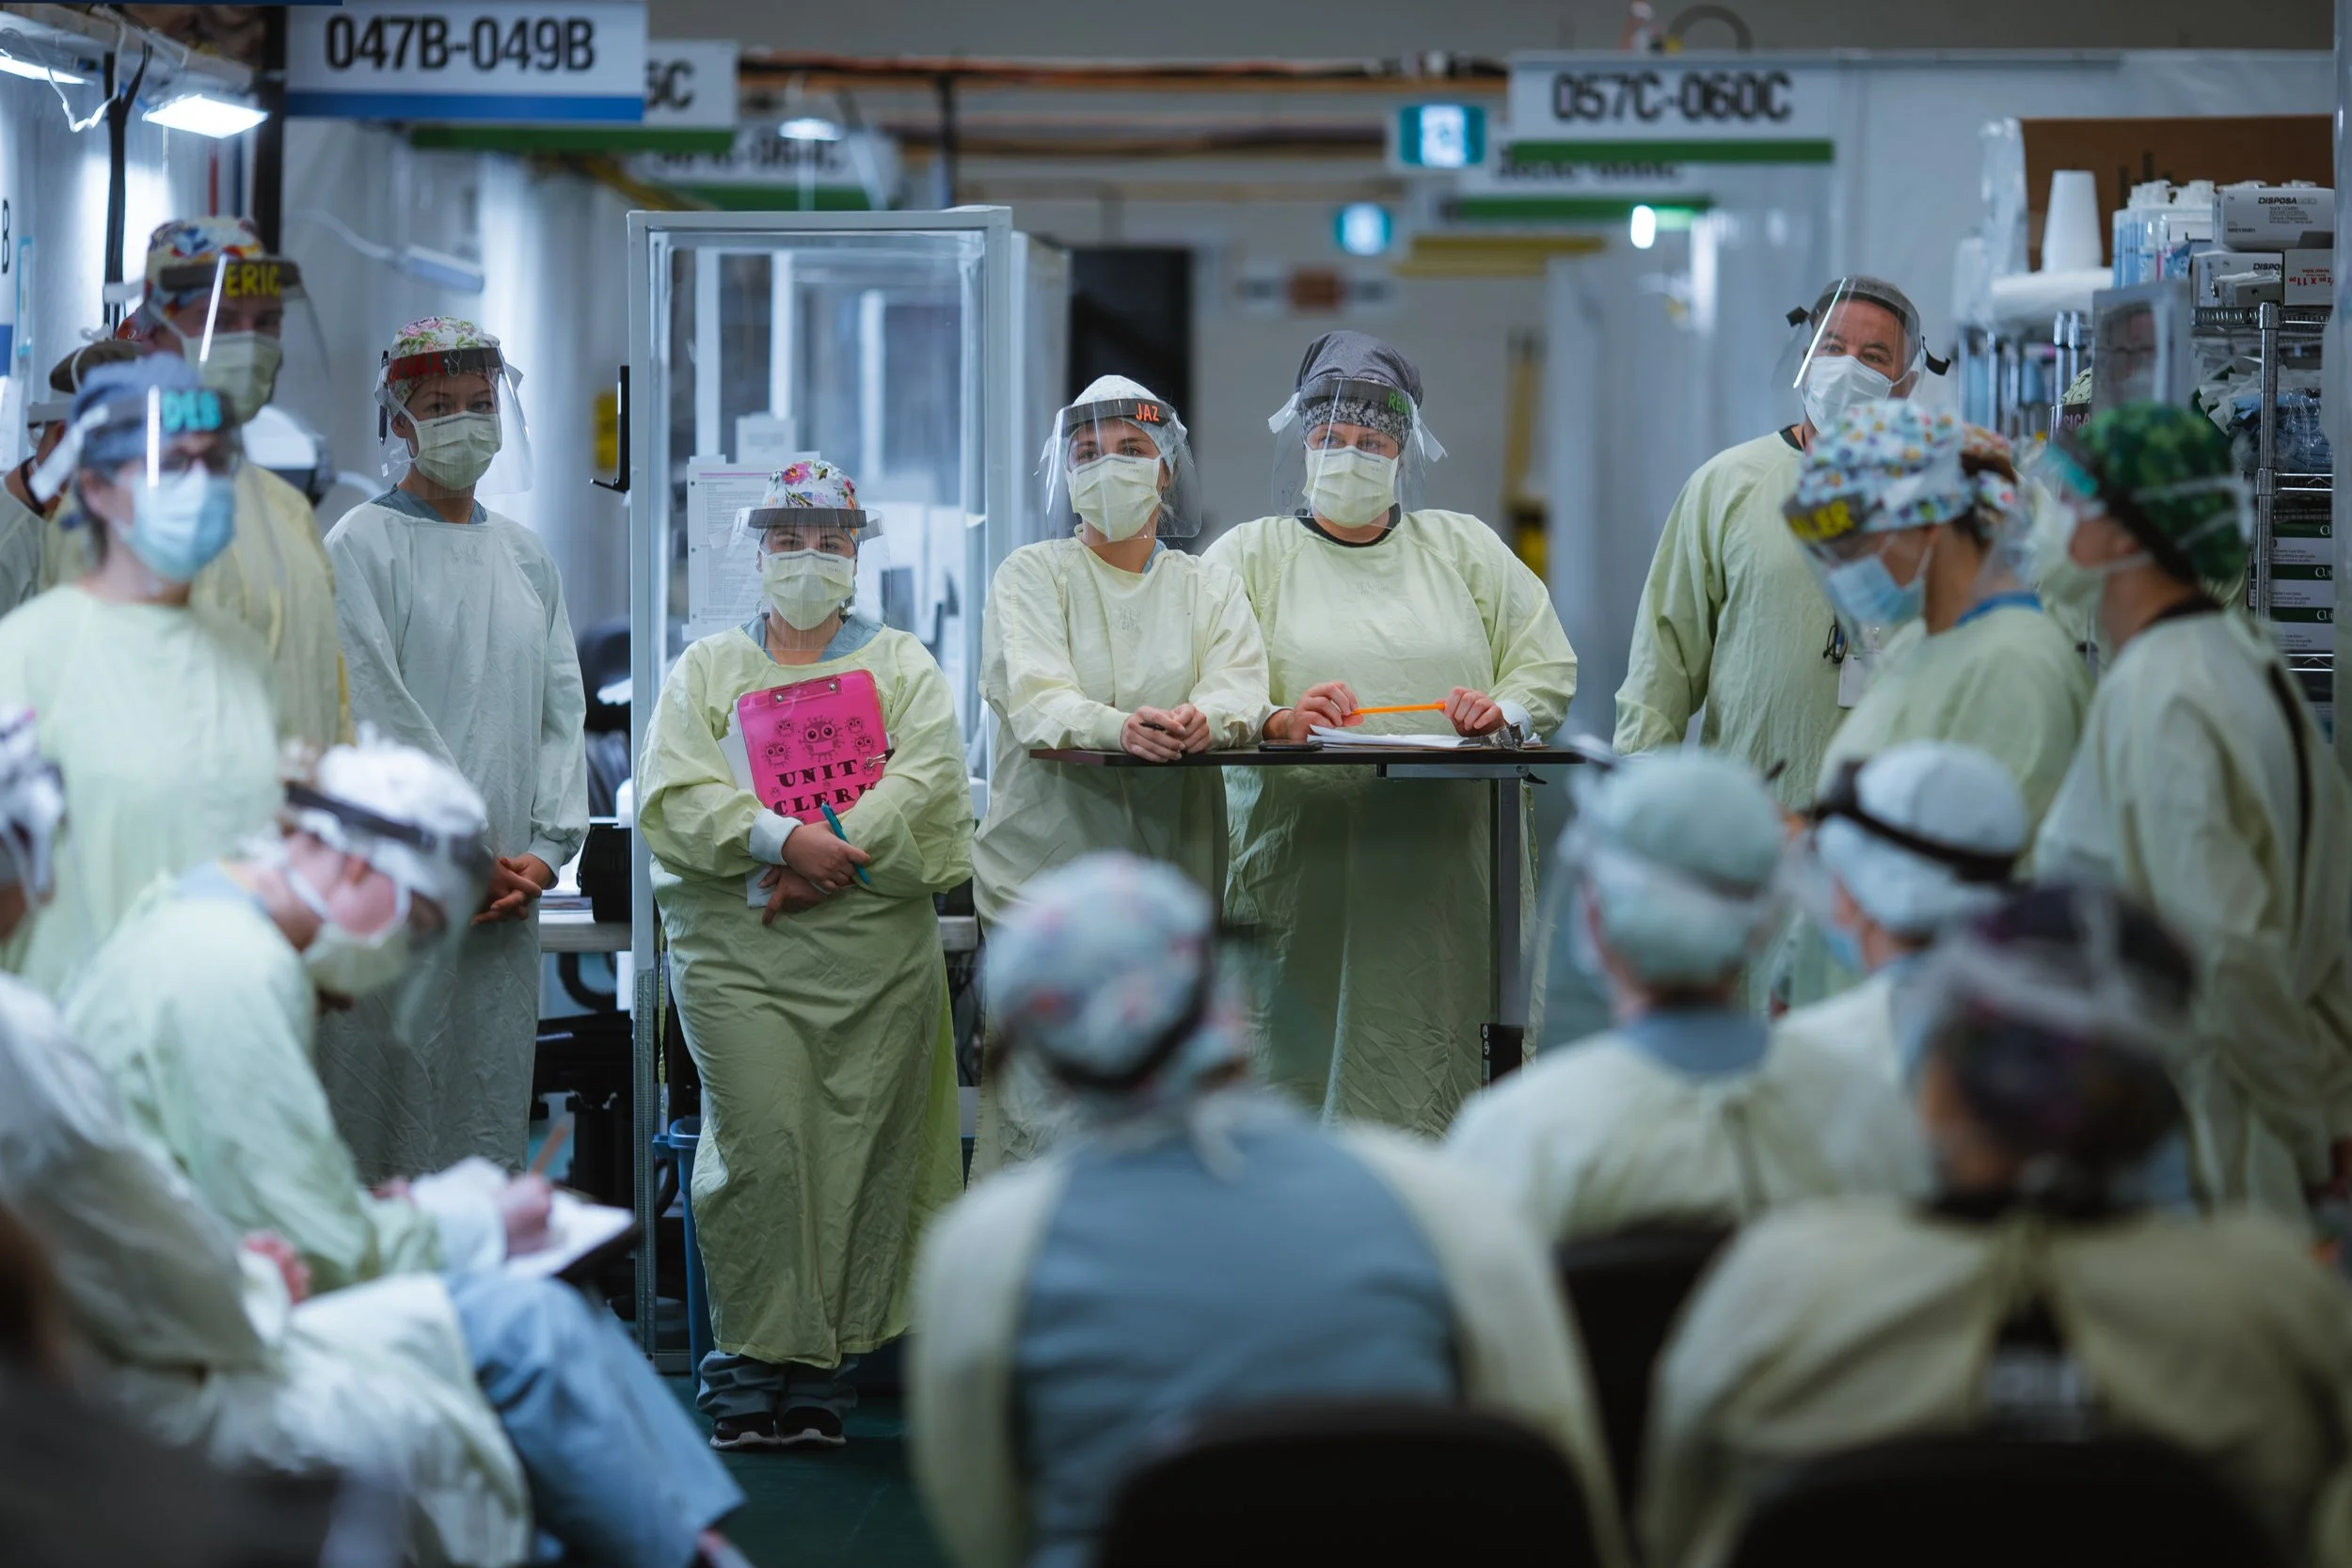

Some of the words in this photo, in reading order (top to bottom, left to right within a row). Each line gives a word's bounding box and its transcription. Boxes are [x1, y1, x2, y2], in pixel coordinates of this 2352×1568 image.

[326, 15, 596, 71] 047B-049B
[1552, 71, 1793, 123] 057C-060C
[224, 263, 280, 298] ERIC
[1136, 403, 1160, 422] JAZ
[775, 759, 857, 787] UNIT
